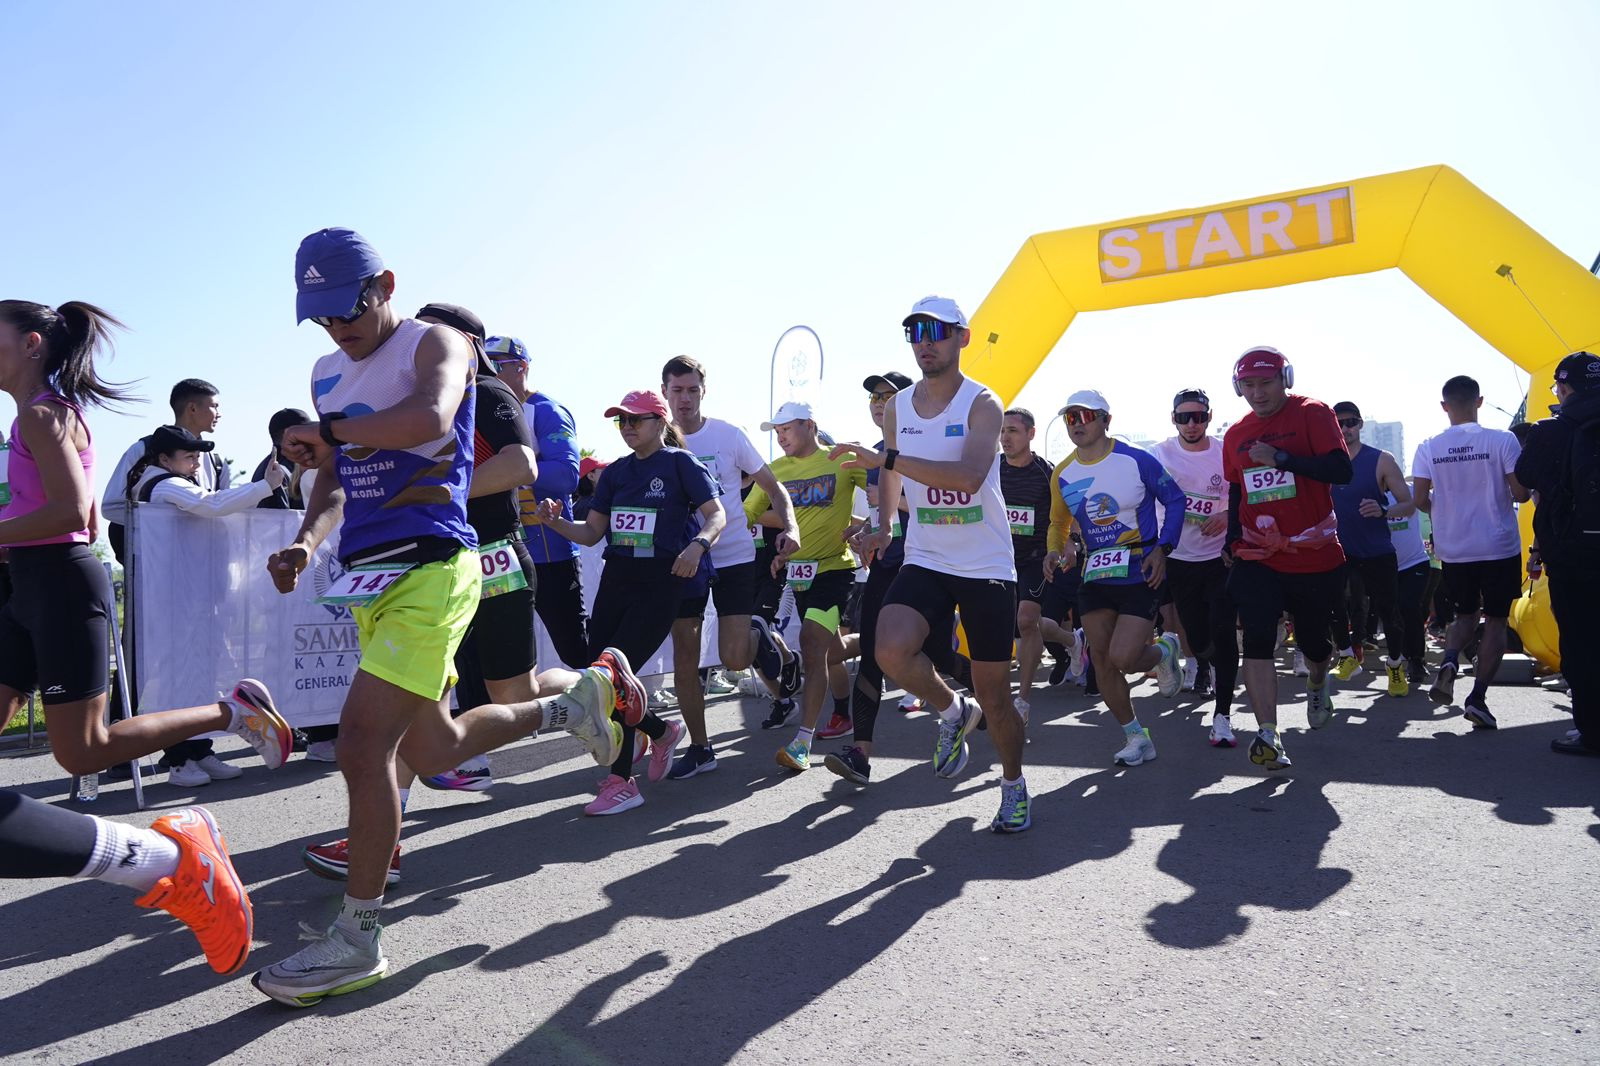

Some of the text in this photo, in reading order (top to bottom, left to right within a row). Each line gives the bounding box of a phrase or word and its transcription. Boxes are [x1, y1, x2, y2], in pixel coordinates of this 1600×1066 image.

[1100, 188, 1348, 279] START
[1432, 453, 1490, 465] SAMRUK MARATHON
[1448, 446, 1474, 455] CHARITY
[1252, 470, 1287, 489] 592
[927, 486, 971, 505] 050
[1185, 497, 1213, 514] 248
[615, 513, 646, 531] 521
[1095, 534, 1116, 543] TEAM
[480, 550, 510, 576] 09
[1092, 551, 1121, 568] 354
[347, 572, 402, 594] 147
[295, 675, 351, 690] GENERAL
